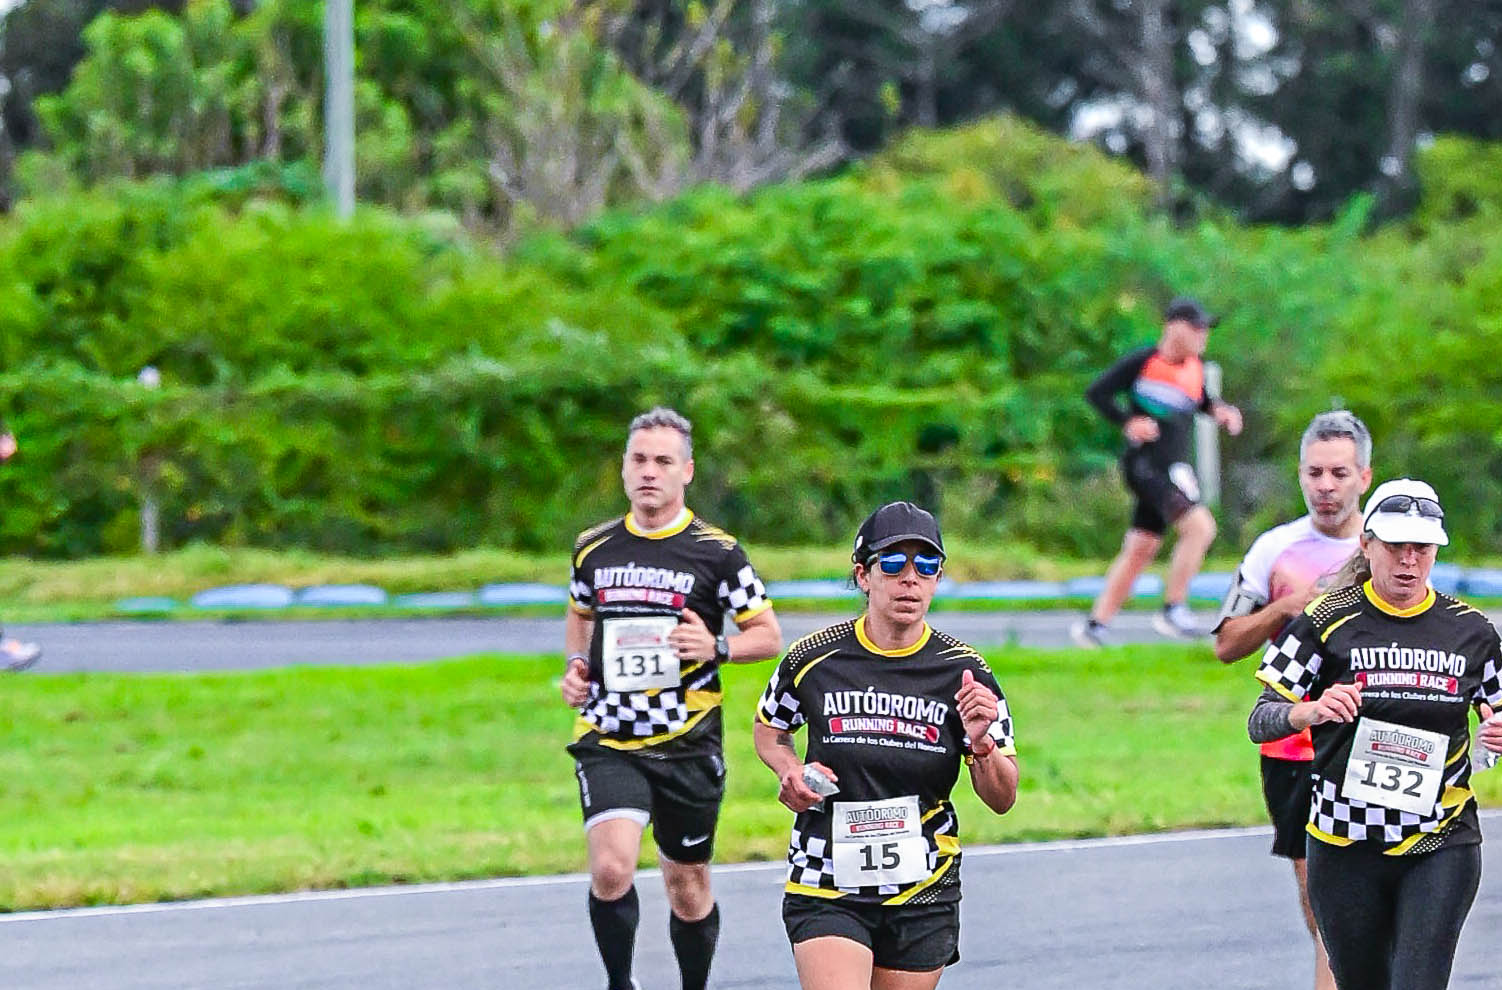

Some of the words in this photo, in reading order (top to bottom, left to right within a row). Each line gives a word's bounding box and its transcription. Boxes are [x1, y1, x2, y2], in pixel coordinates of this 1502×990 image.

[616, 655, 664, 677] 131
[1350, 642, 1466, 677] AUTÓDROMO
[1367, 673, 1417, 686] RUNNING
[1420, 674, 1448, 691] RACE
[823, 686, 948, 725] AUTÓDROMO
[842, 718, 894, 731] RUNNING
[896, 720, 928, 739] RACE
[1369, 729, 1434, 754] AUTÓDROMO
[1360, 761, 1423, 797] 132
[845, 806, 908, 824] AUTÓDROMO
[860, 843, 901, 871] 15
